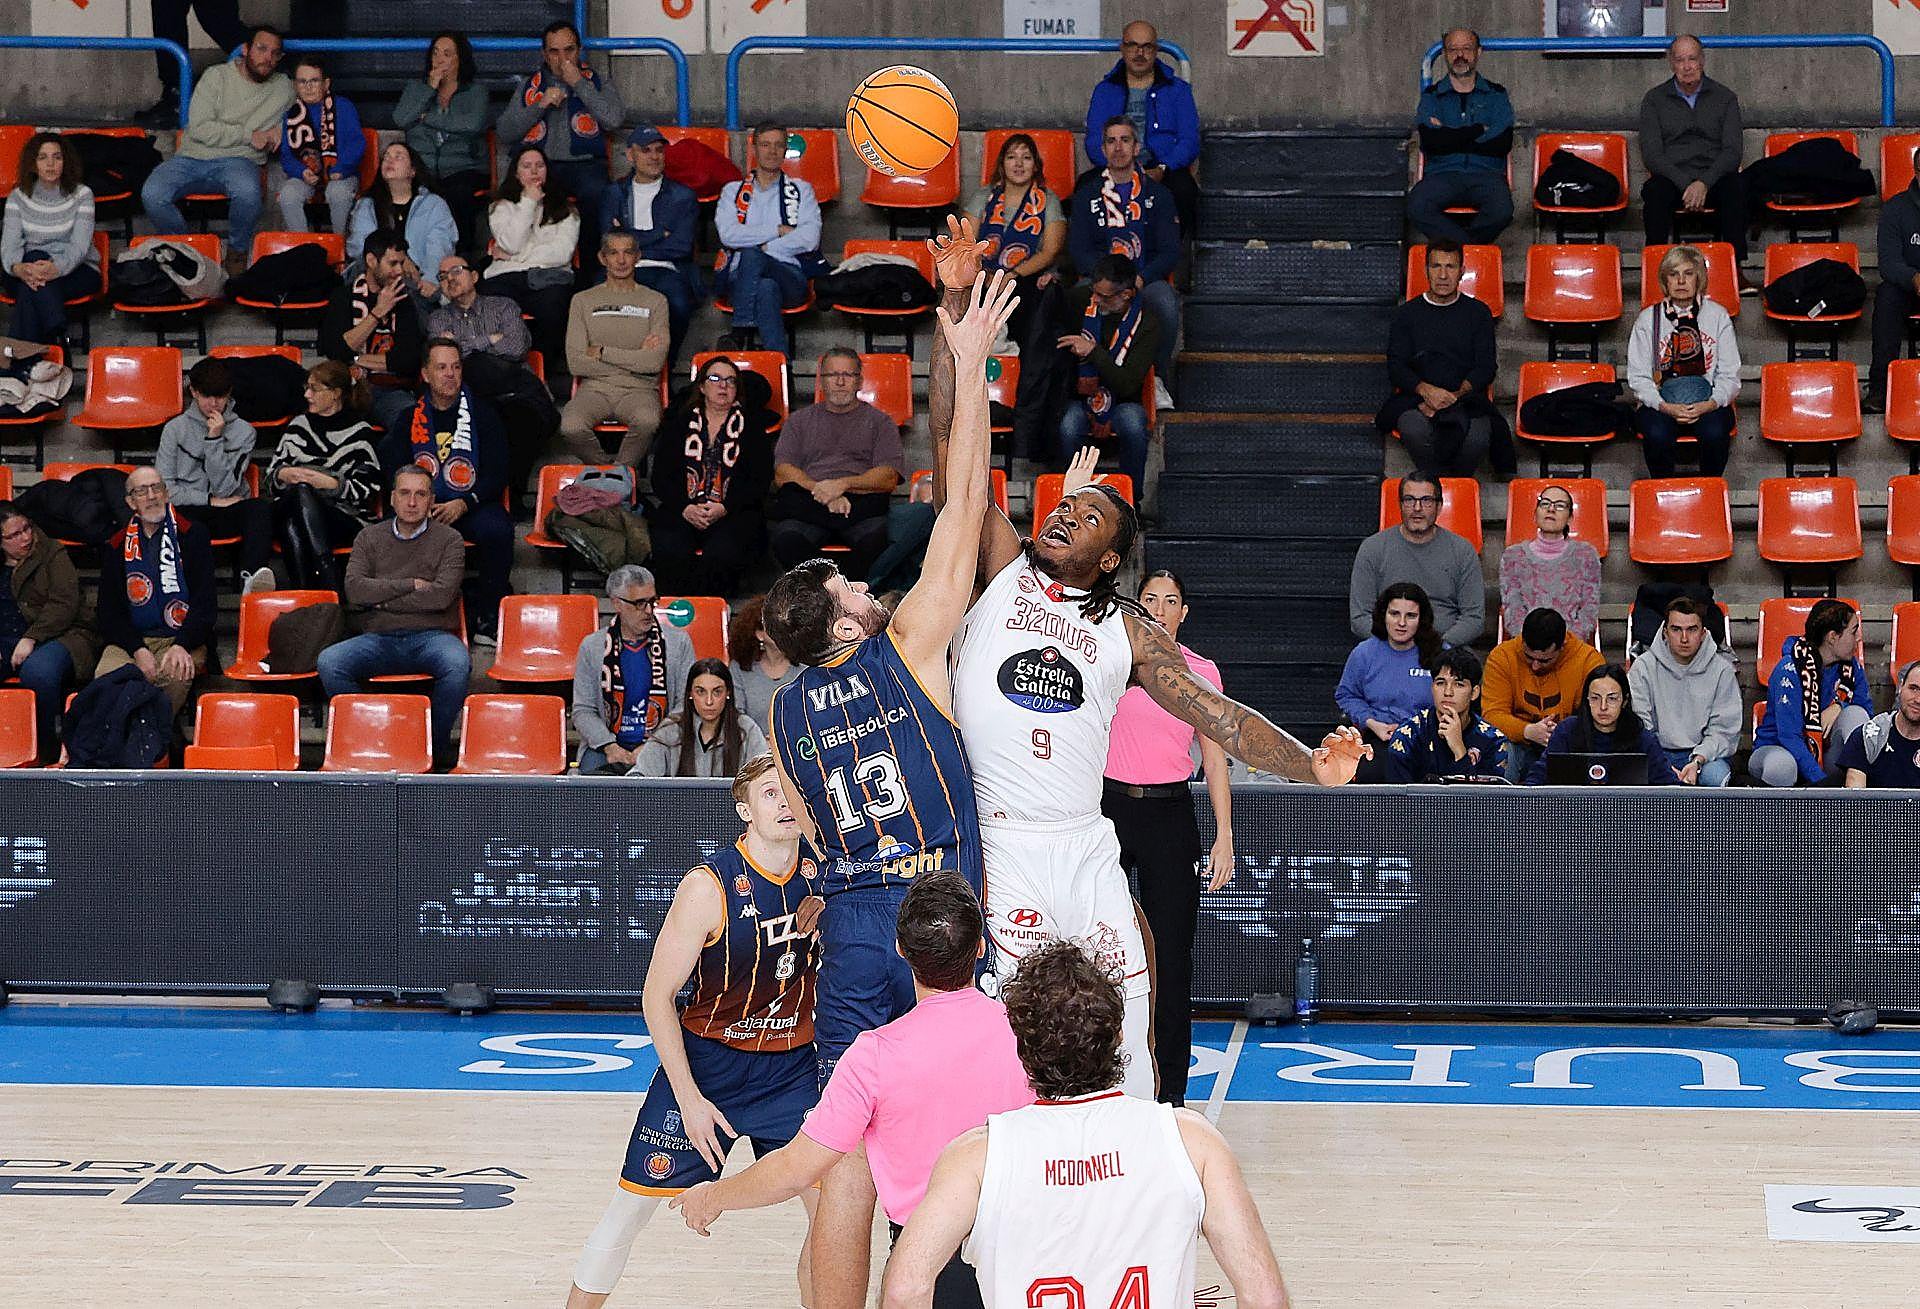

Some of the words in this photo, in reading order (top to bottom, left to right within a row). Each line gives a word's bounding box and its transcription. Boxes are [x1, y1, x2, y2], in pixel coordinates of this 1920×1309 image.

[1024, 18, 1076, 35] FUMAR
[1014, 658, 1075, 689] Estrella
[1014, 674, 1071, 701] Galicia
[808, 674, 870, 712] VILA
[1032, 695, 1054, 710] 0,0
[819, 725, 840, 737] GRUPO
[821, 706, 909, 750] IBEREÓLICA
[1032, 728, 1052, 760] 9
[824, 750, 909, 834] 13
[775, 951, 797, 980] 8
[723, 1027, 757, 1041] Burgos
[639, 1133, 649, 1144] DE
[0, 1159, 530, 1180] PRIMERA
[1045, 1150, 1125, 1187] MCDONNELL
